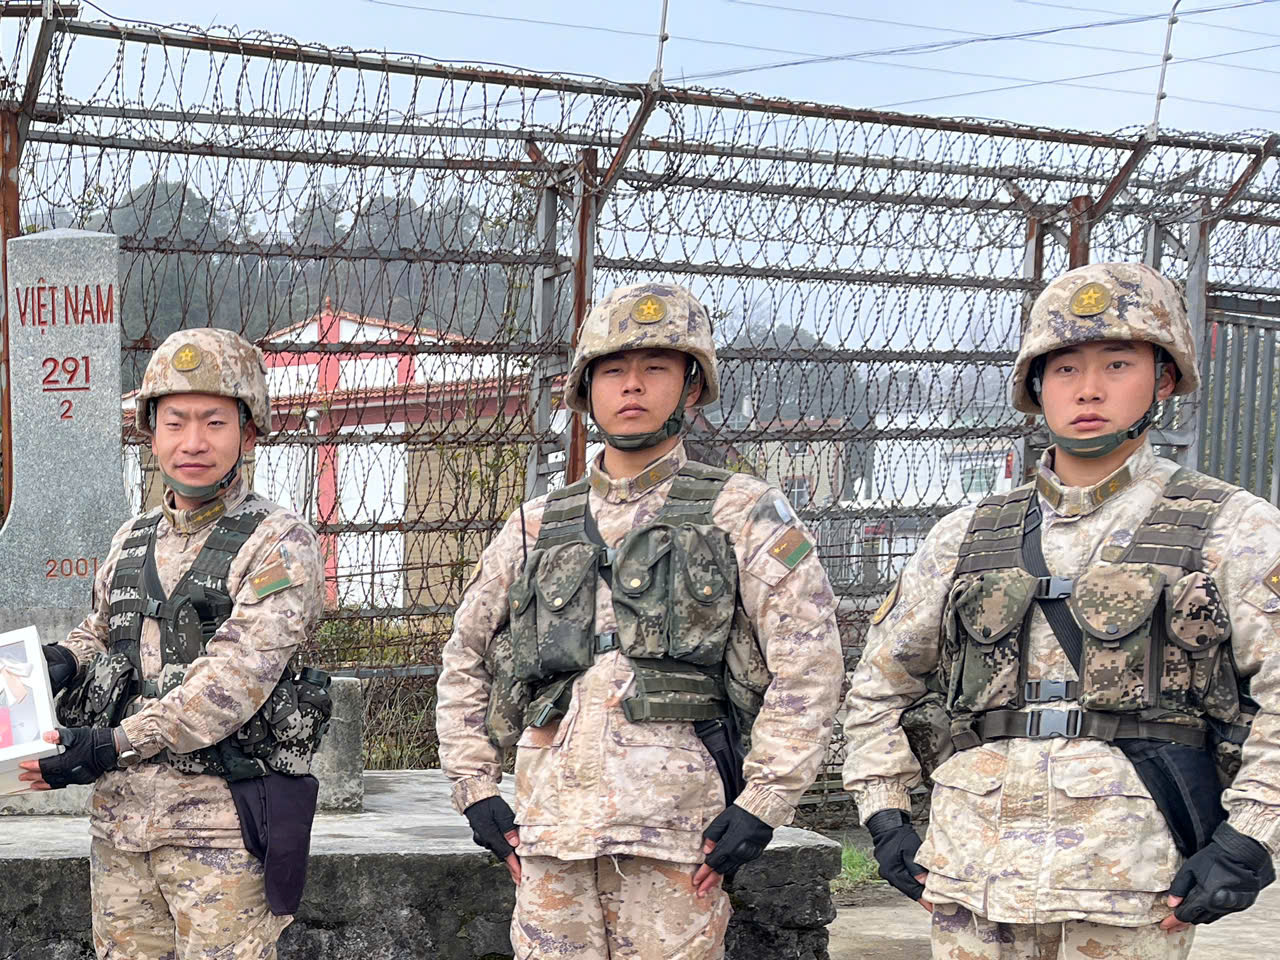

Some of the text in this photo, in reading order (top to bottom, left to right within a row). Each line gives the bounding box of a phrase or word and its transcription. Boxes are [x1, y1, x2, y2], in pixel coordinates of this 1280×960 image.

[16, 278, 114, 335] VIỆT NAM
[42, 356, 90, 386] 291
[60, 400, 73, 420] 2
[46, 557, 98, 580] 2001
